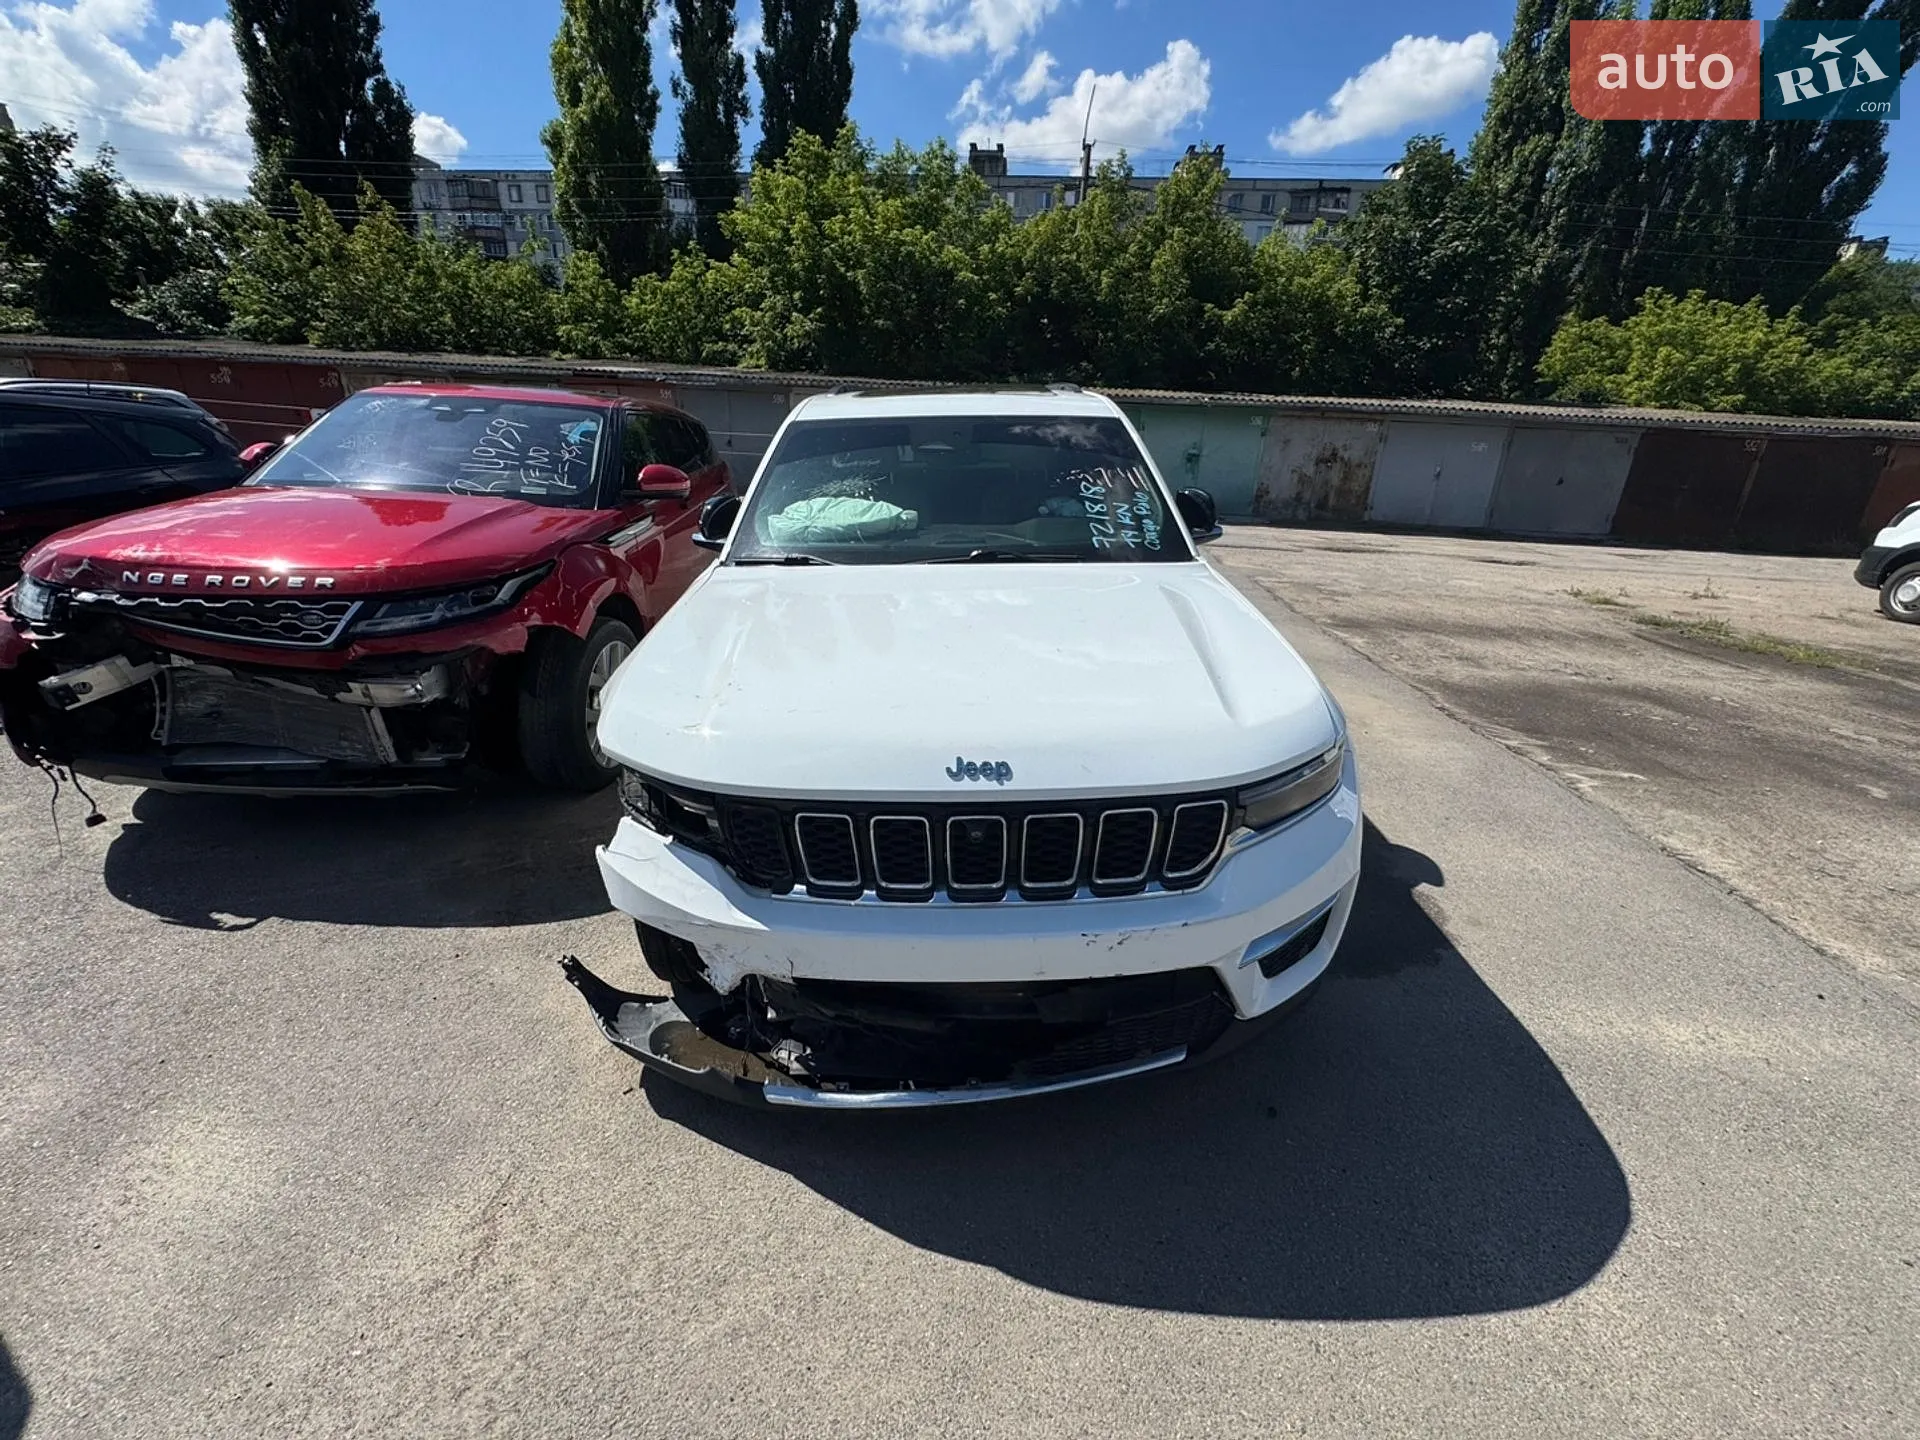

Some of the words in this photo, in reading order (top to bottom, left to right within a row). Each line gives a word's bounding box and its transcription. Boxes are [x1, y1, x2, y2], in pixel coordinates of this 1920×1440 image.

[122, 571, 189, 586] NGE
[205, 575, 335, 588] ROVER
[945, 756, 1013, 786] Jeep
